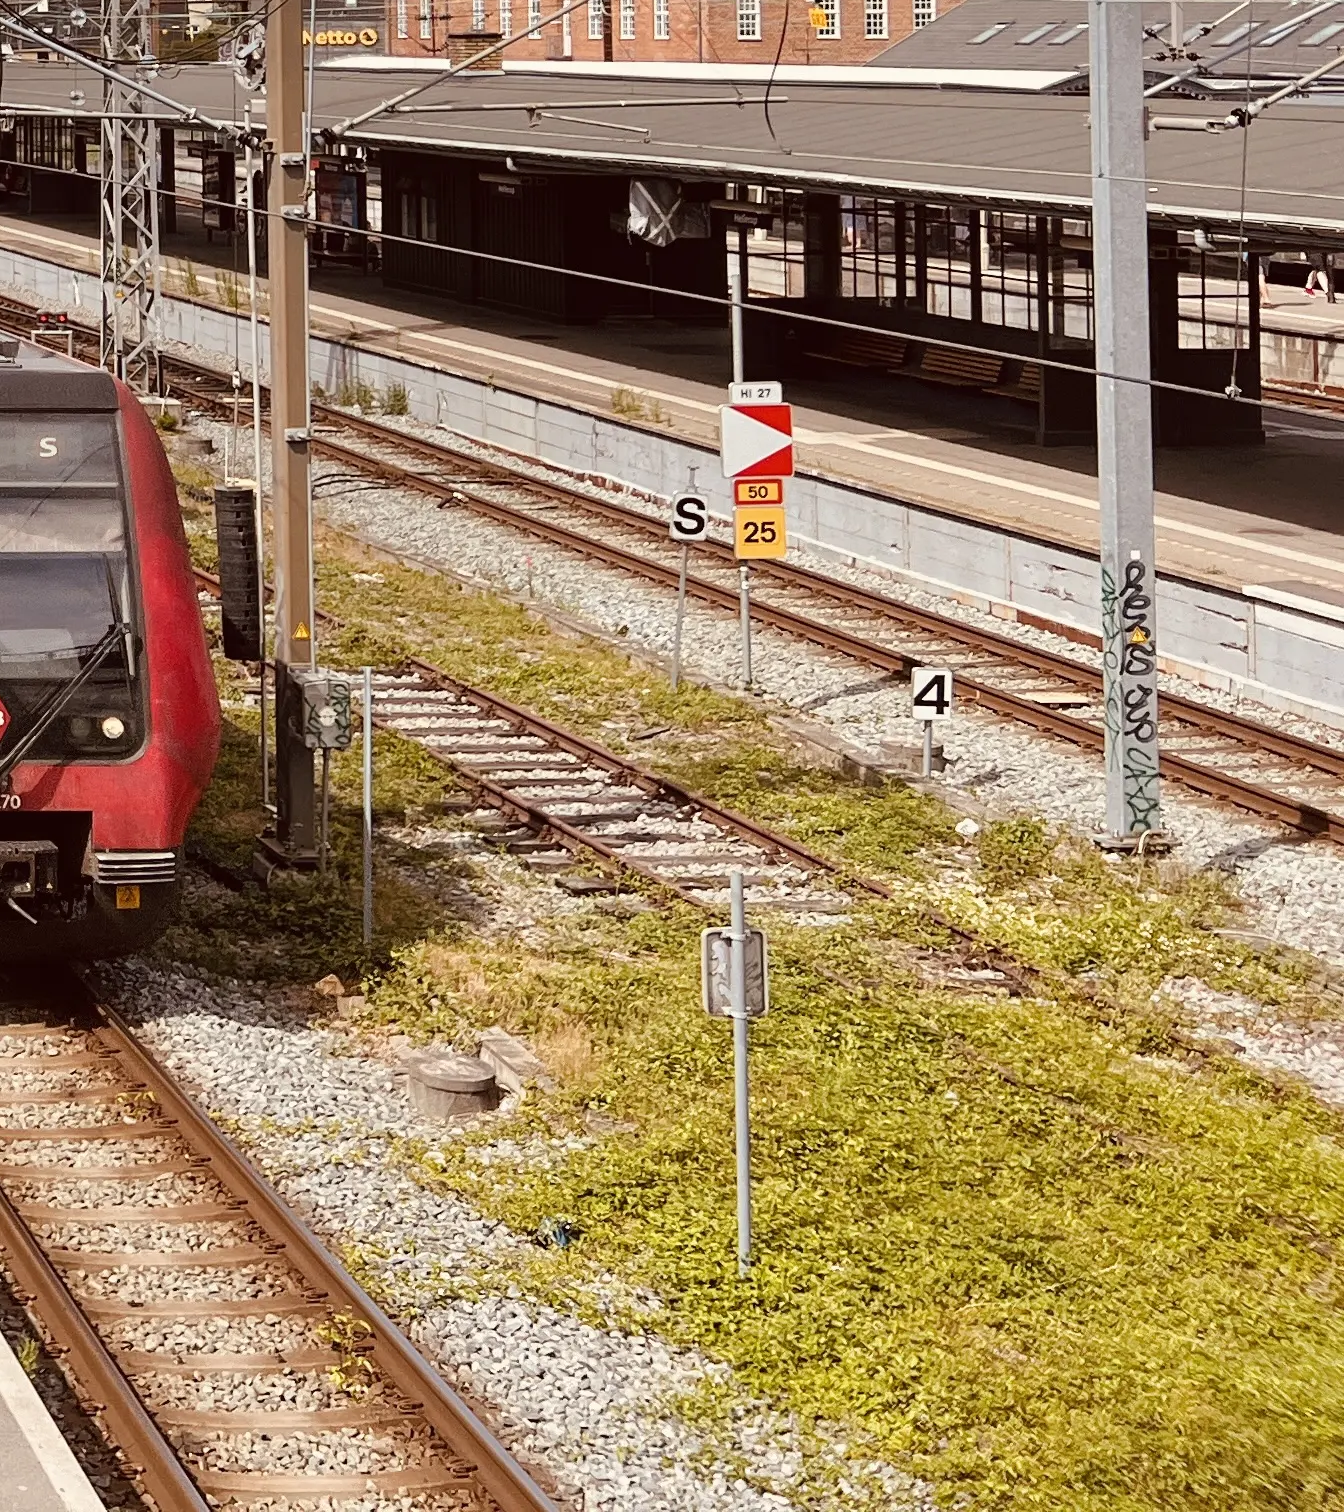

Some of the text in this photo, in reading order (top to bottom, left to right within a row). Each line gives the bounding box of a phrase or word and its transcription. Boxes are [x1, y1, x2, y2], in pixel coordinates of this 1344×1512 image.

[302, 29, 357, 45] Netto
[757, 389, 771, 398] 27
[39, 437, 58, 458] S
[748, 486, 768, 499] 50
[673, 497, 706, 535] S
[743, 521, 777, 543] 25
[914, 674, 949, 714] 4
